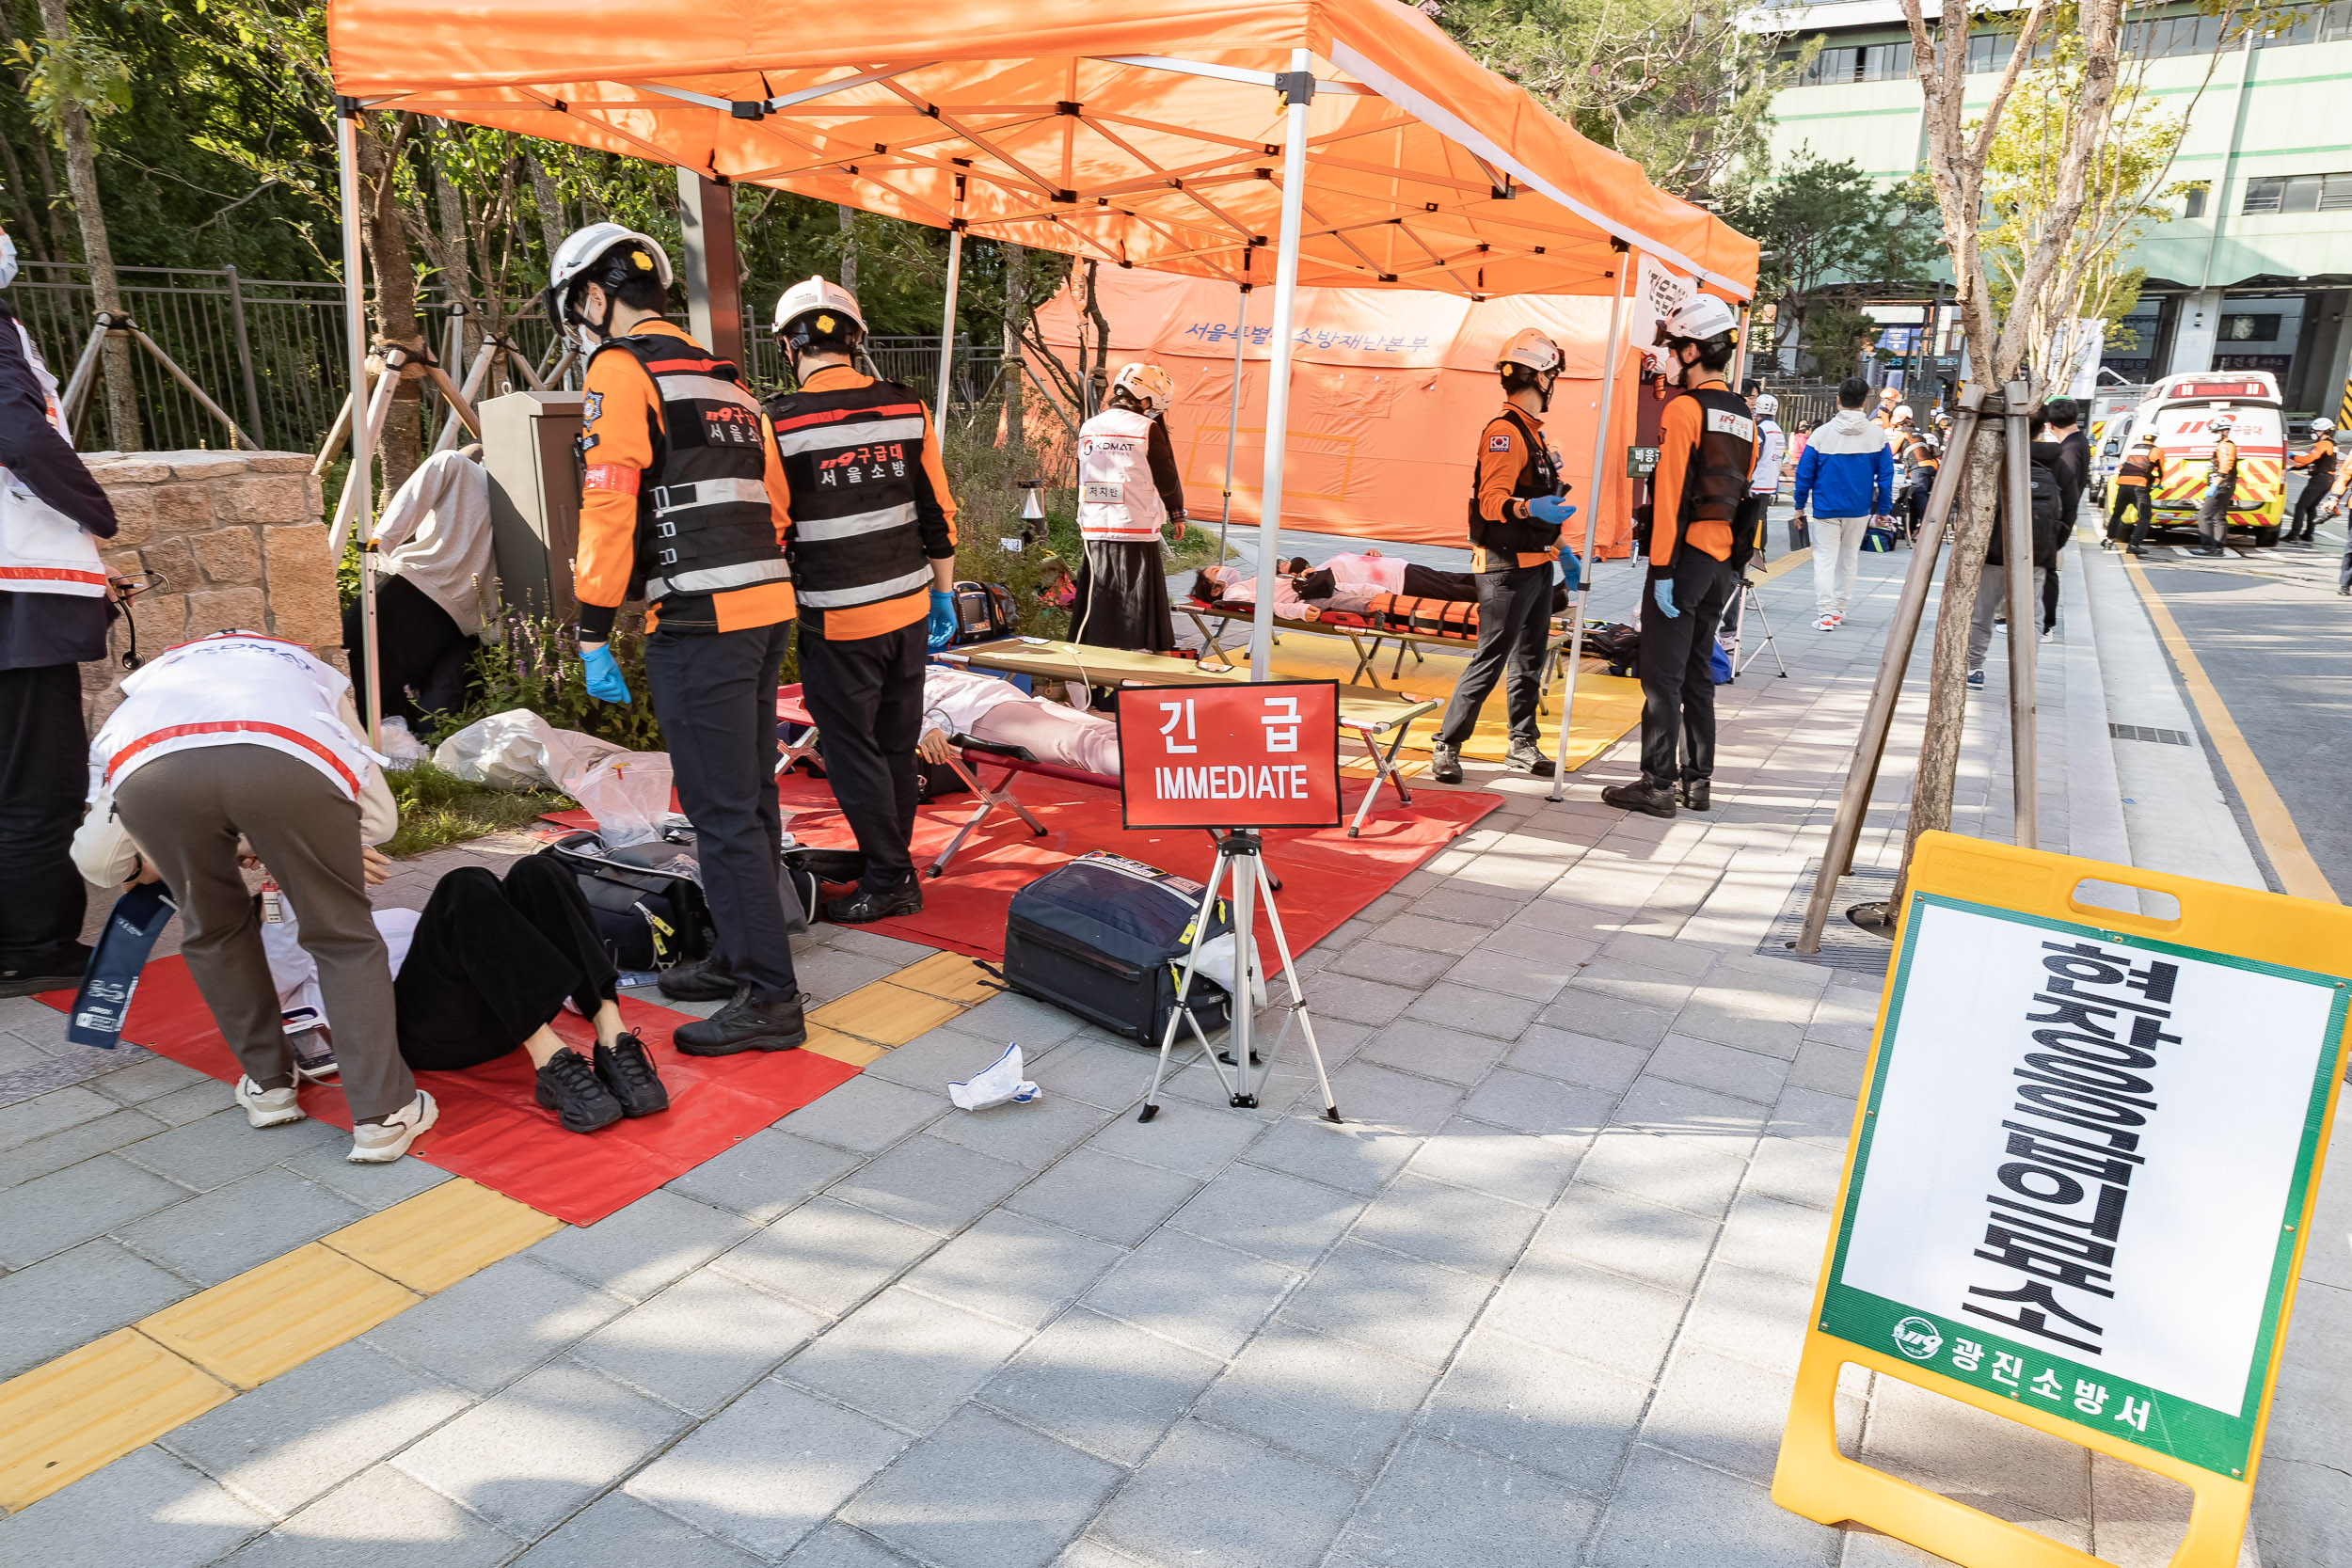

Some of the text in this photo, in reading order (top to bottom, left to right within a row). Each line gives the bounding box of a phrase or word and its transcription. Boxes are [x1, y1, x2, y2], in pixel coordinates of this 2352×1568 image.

[709, 423, 760, 445] 서울소
[1094, 442, 1136, 451] KDMAT
[193, 642, 317, 673] KDMAT
[1155, 764, 1309, 800] IMMEDIATE
[1962, 940, 2183, 1356] 현장응급의료소
[1950, 1336, 2152, 1433] 광진소방서
